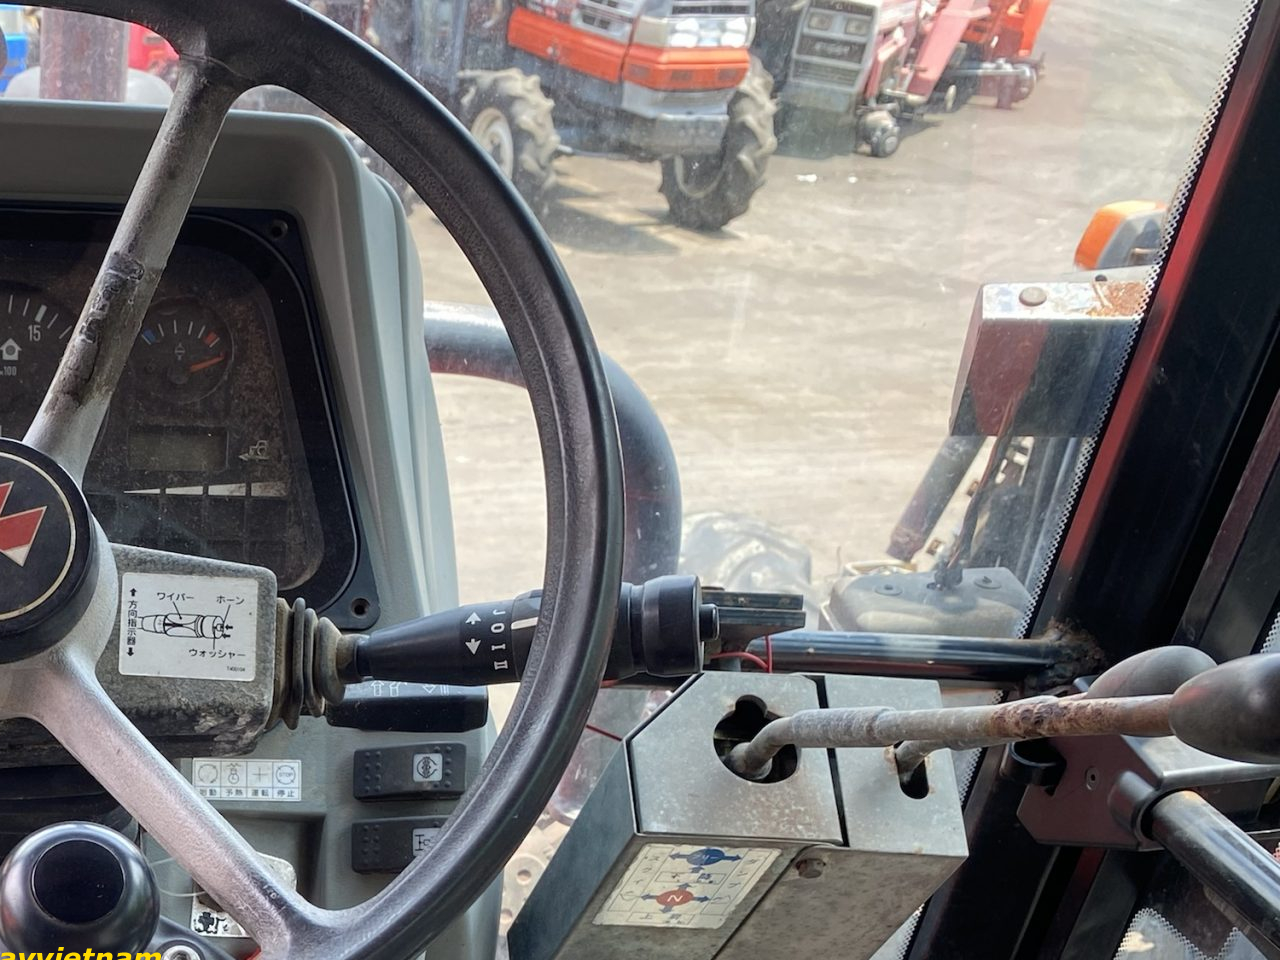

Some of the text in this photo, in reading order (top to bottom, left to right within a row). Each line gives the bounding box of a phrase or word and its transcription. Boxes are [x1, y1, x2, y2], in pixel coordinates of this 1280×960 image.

[27, 324, 42, 342] 15
[216, 595, 246, 605] ホーン
[127, 600, 138, 646] 方向指示器
[188, 648, 247, 660] ウォッシャー
[276, 789, 295, 798] 停止
